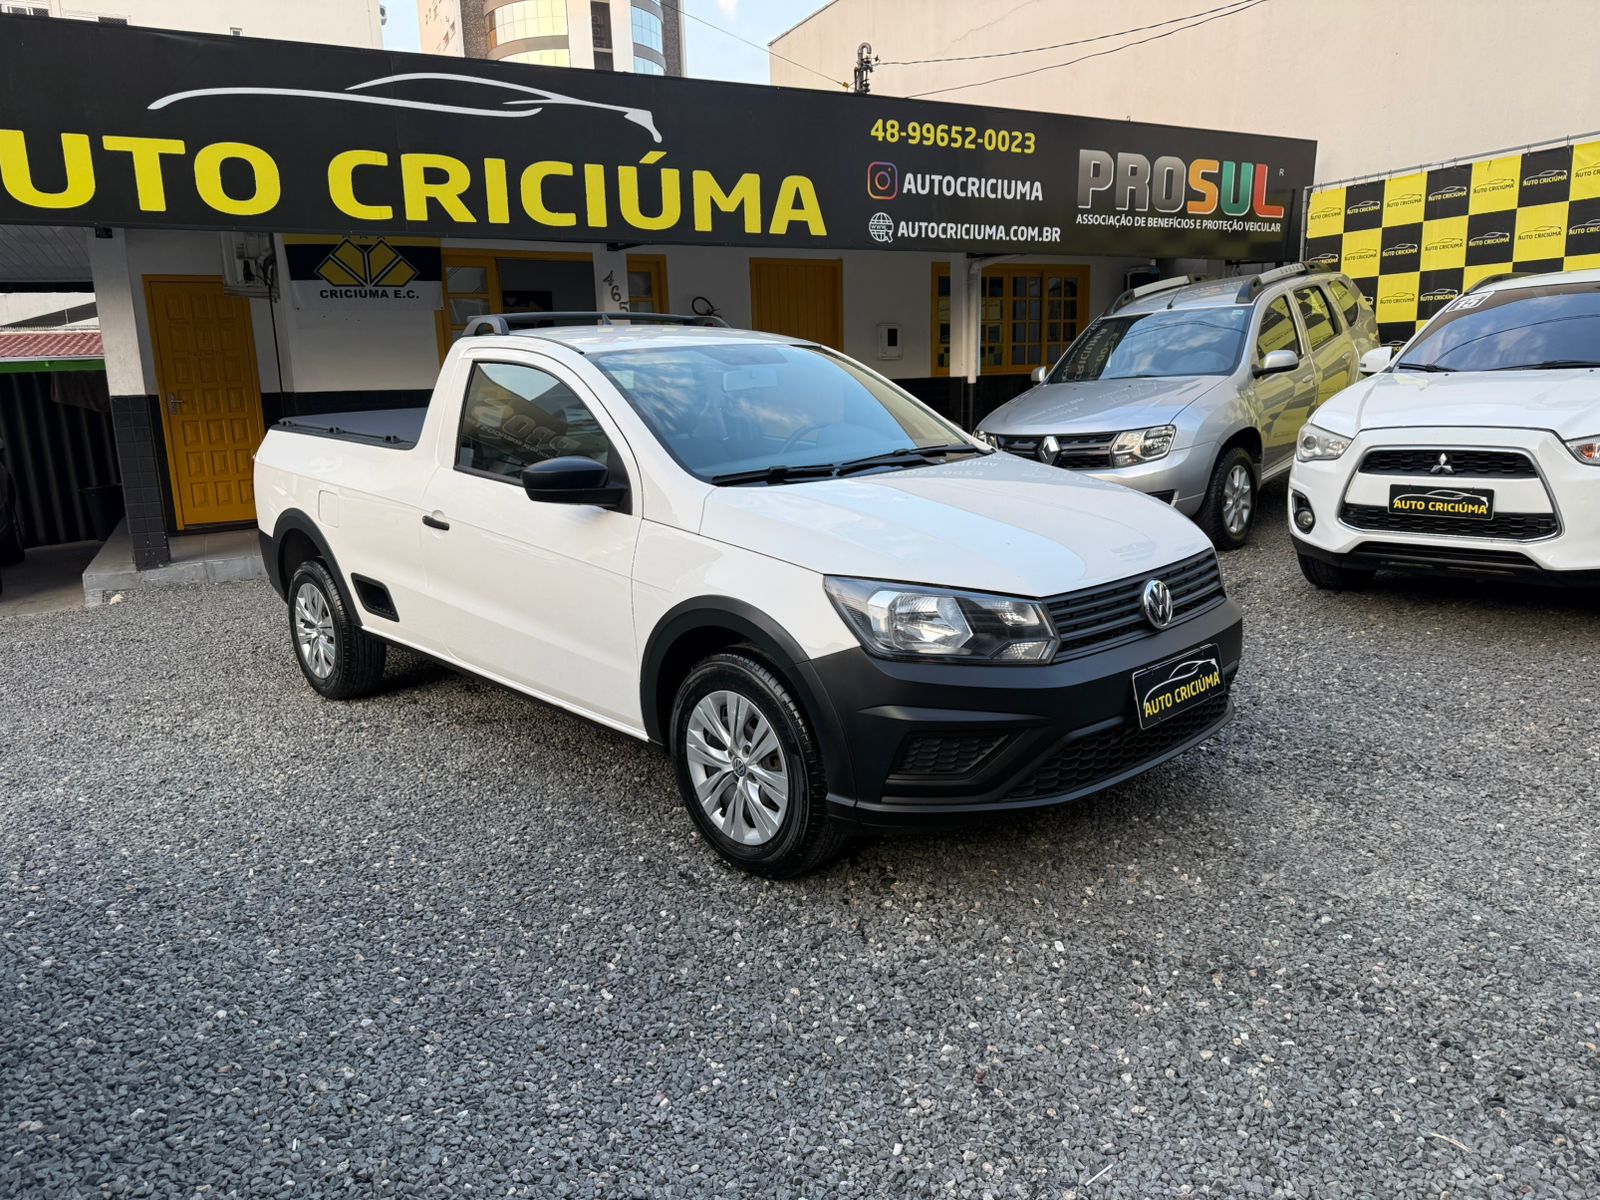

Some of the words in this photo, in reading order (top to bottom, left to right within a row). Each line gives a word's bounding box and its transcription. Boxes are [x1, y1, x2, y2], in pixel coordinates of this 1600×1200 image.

[870, 118, 1036, 154] 48-99652-0023
[1523, 179, 1539, 187] AUTO
[1539, 174, 1568, 184] CRICIÚMA
[1575, 170, 1591, 178] AUTO
[0, 129, 281, 216] UTO
[328, 150, 826, 236] CRICIÚMA
[902, 172, 1043, 201] AUTOCRICIUMA
[1077, 149, 1285, 219] PROSUL
[1488, 183, 1515, 193] CRICIÚMA
[1428, 194, 1442, 202] AUTO
[1076, 213, 1133, 229] ASSOCIAÇÃO
[1134, 216, 1147, 227] DE
[1147, 216, 1195, 229] BENEFÍCIOS
[1196, 219, 1201, 229] E
[1202, 219, 1244, 232] PROTEÇÃO
[1244, 221, 1281, 232] VEICULAR
[897, 220, 1061, 242] AUTOCRICIUMA.COM.BR
[1518, 233, 1533, 241] AUTO
[1534, 230, 1562, 239] CRICIÚMA
[1468, 239, 1483, 247] AUTO
[319, 287, 389, 299] CRICIÚMA
[393, 289, 420, 299] E.C.
[1393, 499, 1425, 510] AUTO
[1428, 501, 1488, 514] CRICIÚMA
[1144, 692, 1173, 718] AUTO
[1174, 671, 1221, 703] CRICIÚMA
